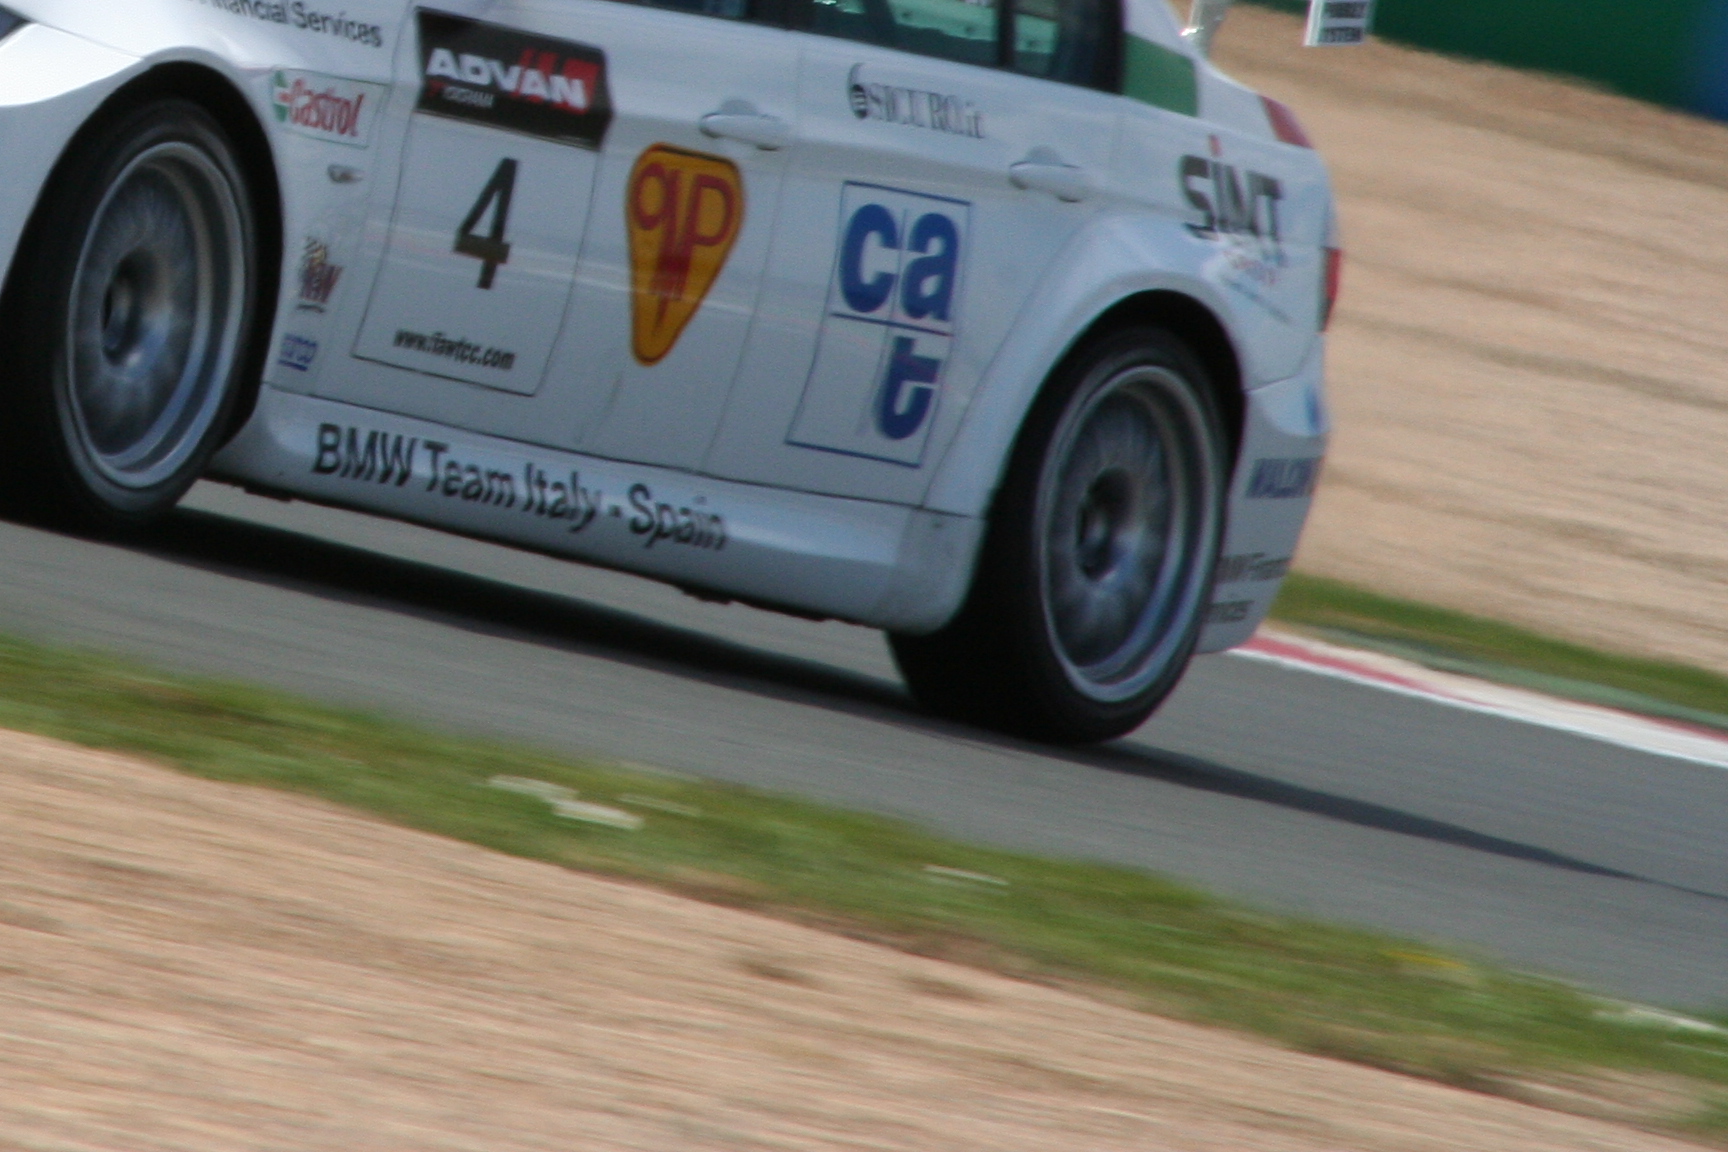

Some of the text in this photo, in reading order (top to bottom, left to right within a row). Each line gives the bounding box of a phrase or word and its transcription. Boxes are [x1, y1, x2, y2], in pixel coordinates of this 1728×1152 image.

[291, 1, 383, 47] Services
[289, 79, 365, 136] Castrol
[426, 48, 588, 110] ADVAN
[453, 158, 520, 290] 4
[311, 424, 418, 486] BMW
[423, 441, 518, 509] Team
[521, 463, 602, 533] Italy
[627, 483, 729, 551] Spain
